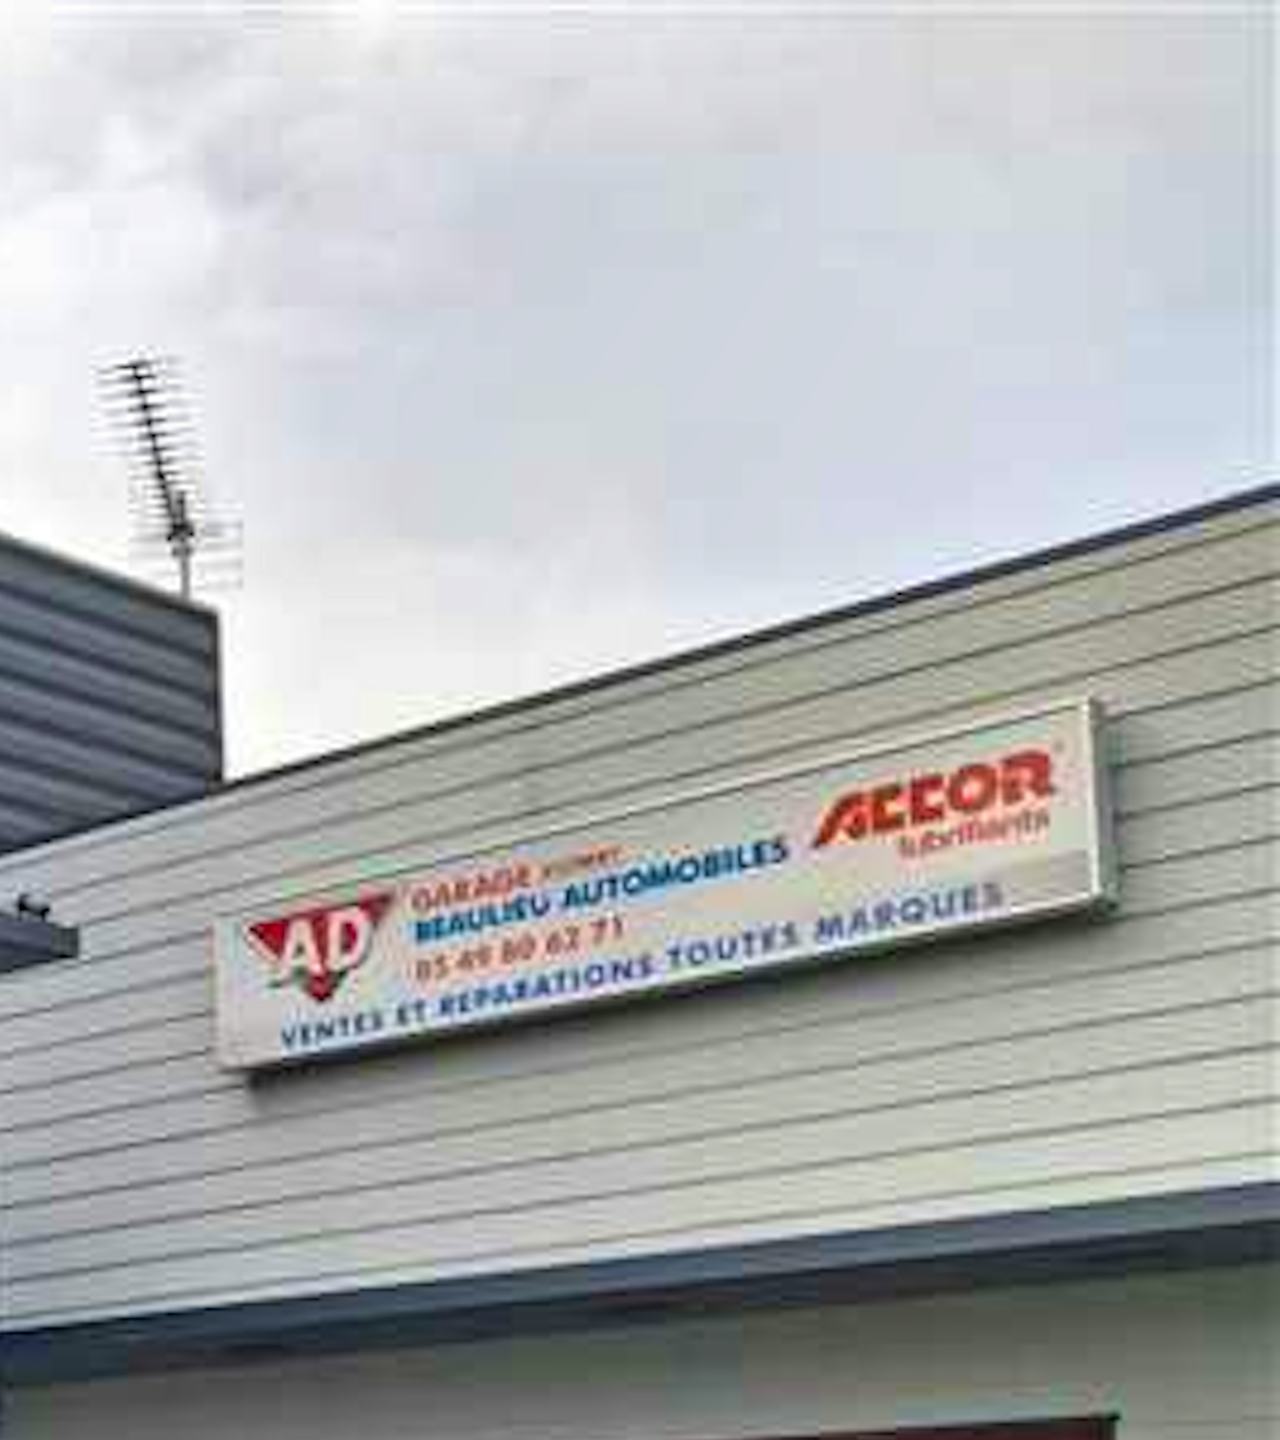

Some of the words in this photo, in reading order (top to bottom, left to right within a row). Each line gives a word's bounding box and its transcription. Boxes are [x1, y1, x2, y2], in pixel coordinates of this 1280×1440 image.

[411, 864, 532, 913] GARAGE
[414, 893, 551, 943] BEAULIEU
[562, 836, 789, 910] AUTOMOBILES
[268, 908, 374, 988] AD
[281, 1011, 385, 1049] VENTES
[397, 999, 428, 1027] ET
[439, 955, 653, 1018] REPARATIONS
[666, 921, 800, 968] TOUTES
[815, 881, 1004, 943] MARQUES
